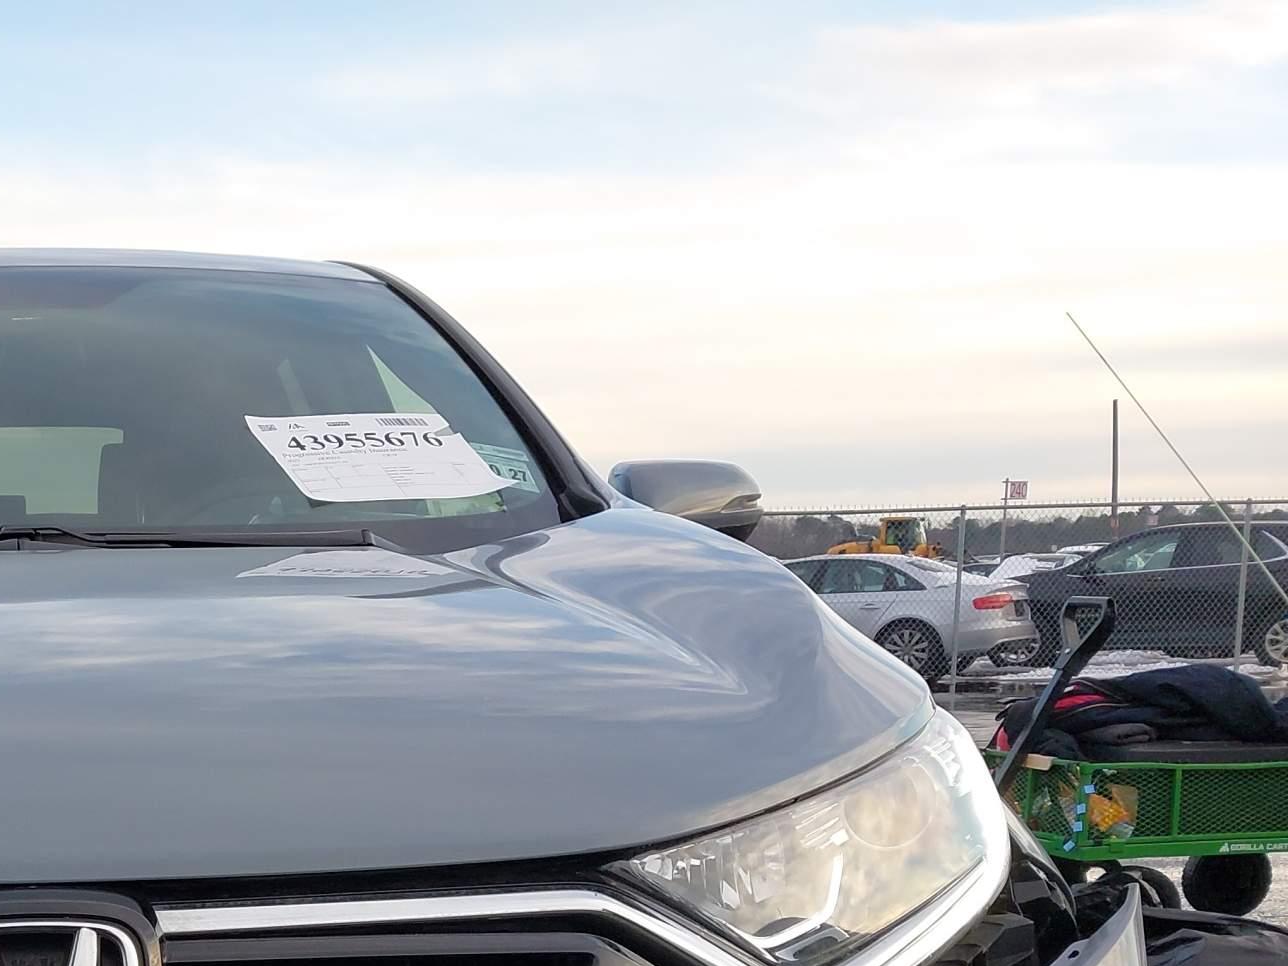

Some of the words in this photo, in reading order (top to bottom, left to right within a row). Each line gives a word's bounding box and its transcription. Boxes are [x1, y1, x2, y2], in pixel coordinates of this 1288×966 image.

[287, 431, 444, 451] 43955676
[509, 468, 527, 482] 27
[1010, 482, 1028, 498] 240
